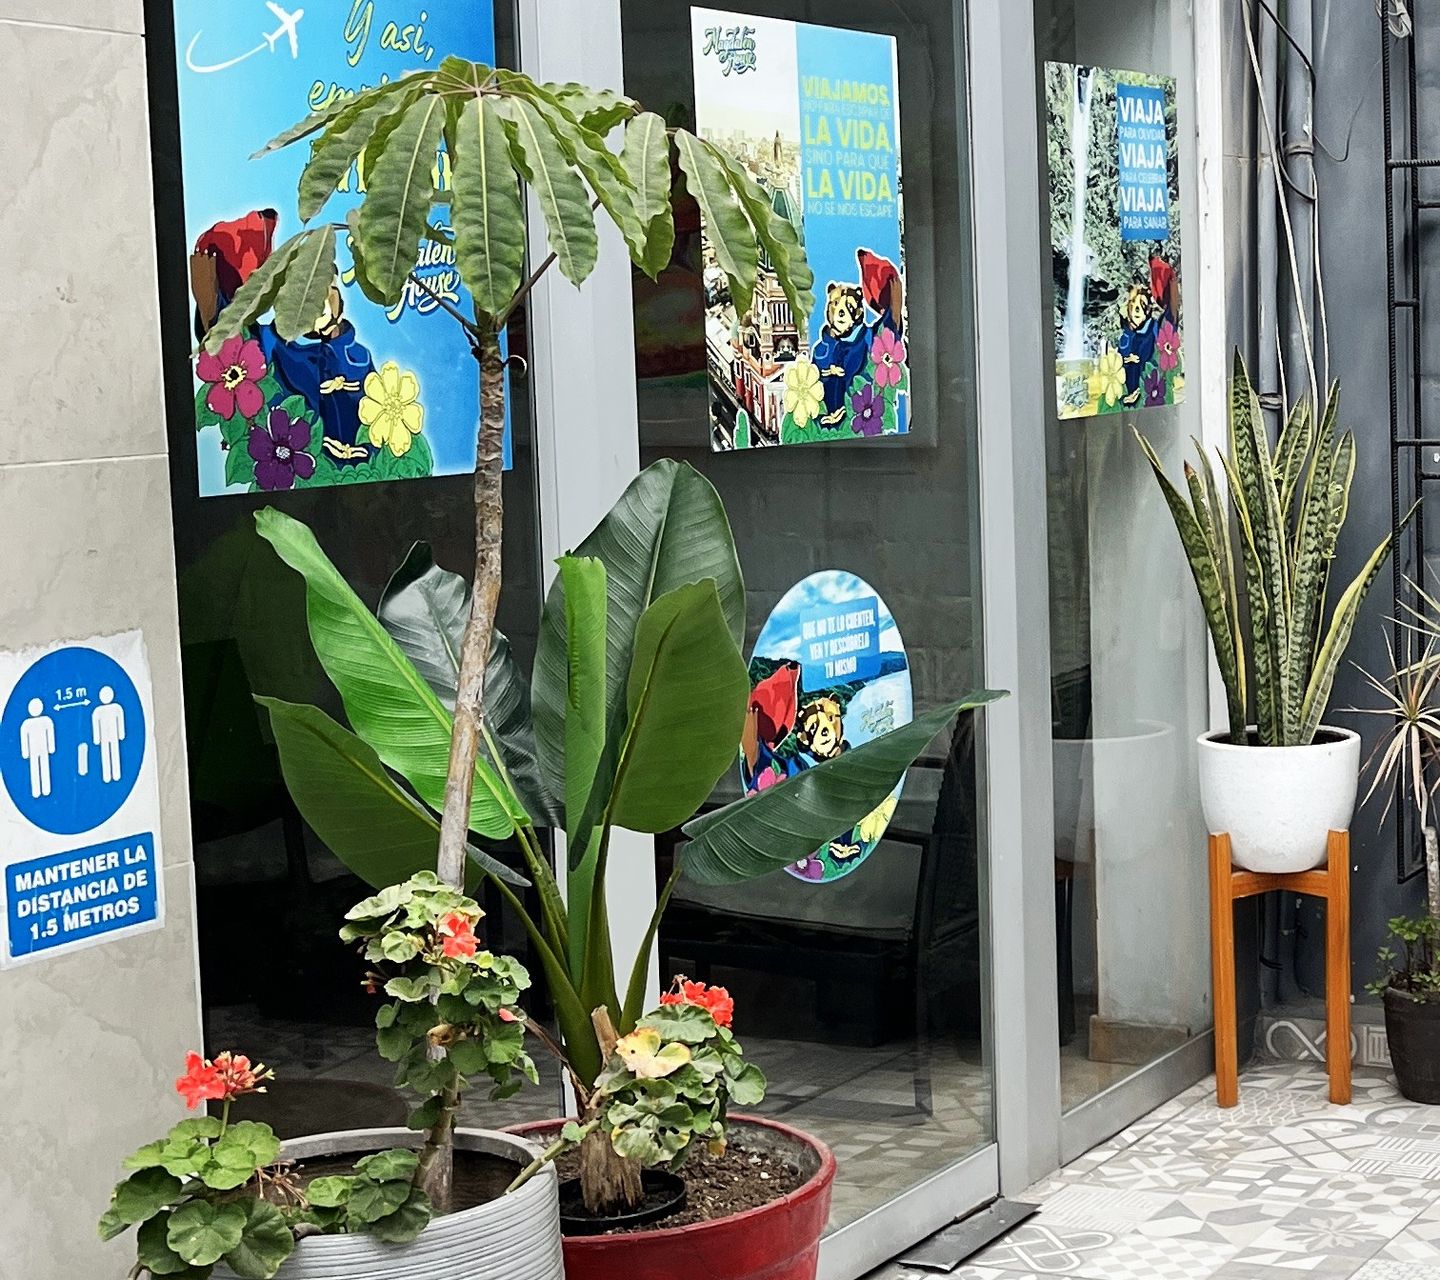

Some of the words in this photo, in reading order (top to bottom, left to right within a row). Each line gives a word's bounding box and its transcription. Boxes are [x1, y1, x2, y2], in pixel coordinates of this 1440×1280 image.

[1118, 96, 1165, 125] VIAJA
[804, 114, 832, 147] LA
[1119, 125, 1137, 140] PARA
[805, 148, 833, 165] SINO
[835, 151, 866, 168] PARA
[1120, 142, 1166, 170] VIAJA
[806, 167, 834, 199] LA
[1120, 186, 1166, 213] VIAJA
[1123, 215, 1143, 230] PARA
[55, 689, 73, 701] 1.5
[76, 687, 87, 698] m
[15, 850, 119, 892] MANTENER
[124, 844, 147, 865] LA
[17, 878, 119, 918] DISTANCIA
[124, 869, 148, 888] DE
[30, 920, 57, 941] 1.5
[63, 896, 140, 932] METROS
